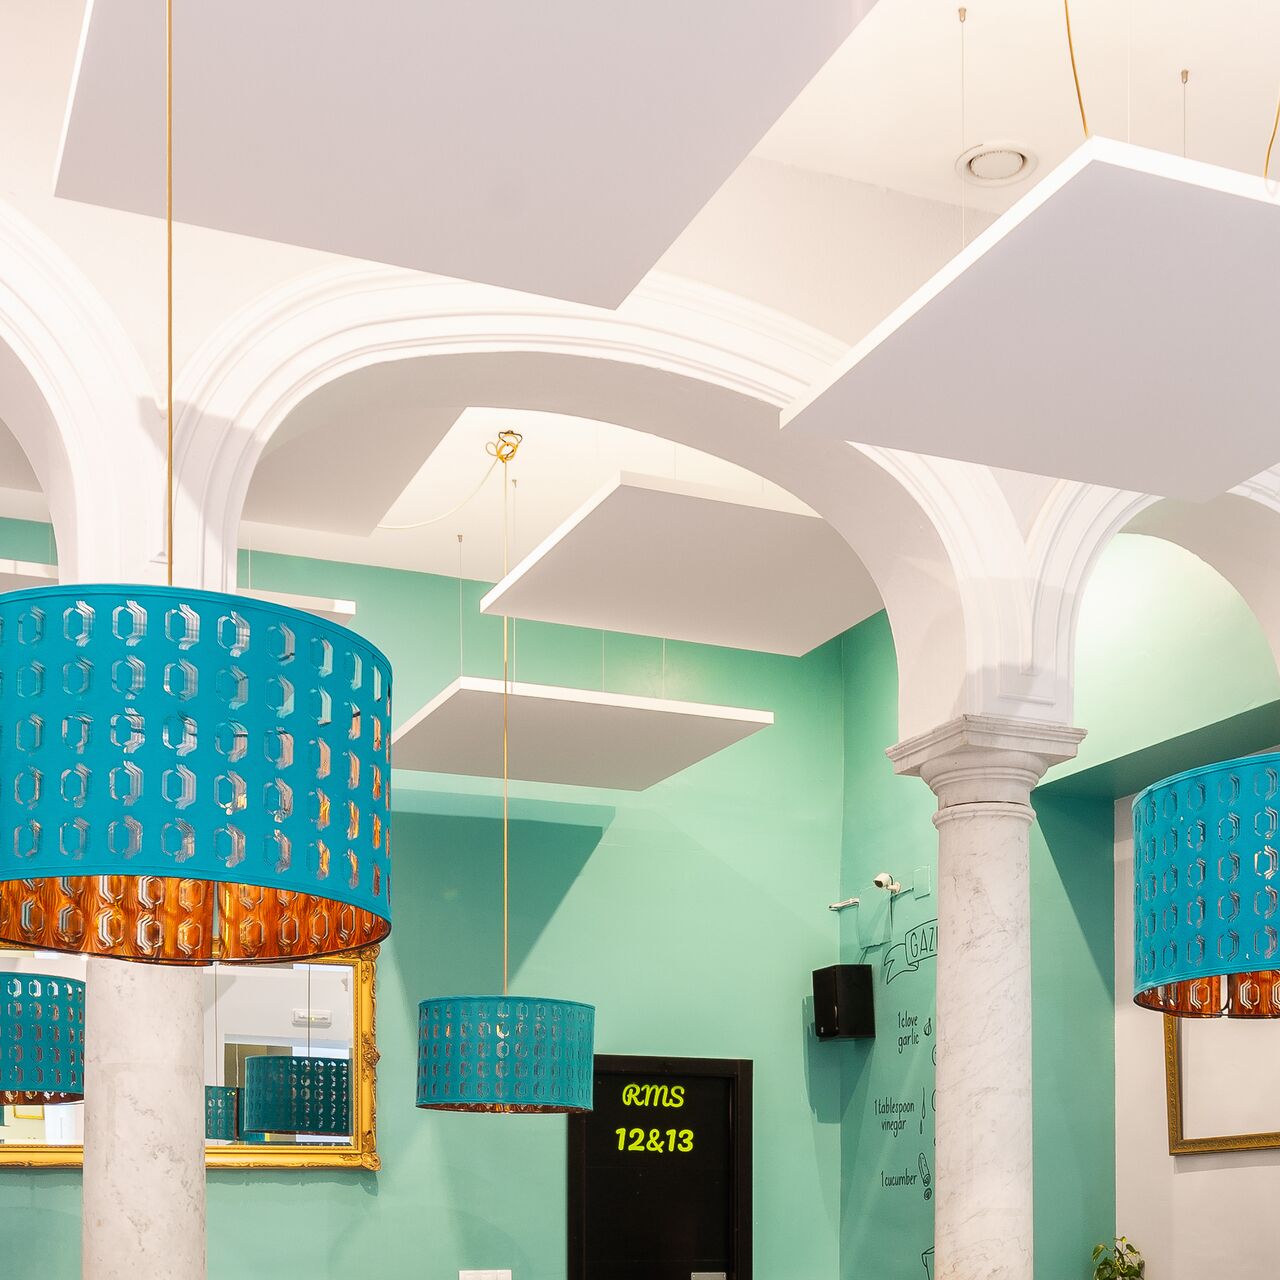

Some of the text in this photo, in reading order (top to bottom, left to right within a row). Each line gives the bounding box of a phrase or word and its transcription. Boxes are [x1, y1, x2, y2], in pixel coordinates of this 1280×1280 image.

[898, 1027, 920, 1054] garlic
[622, 1083, 685, 1108] RMS
[615, 1127, 694, 1153] 12&13
[881, 1118, 907, 1138] vinegar
